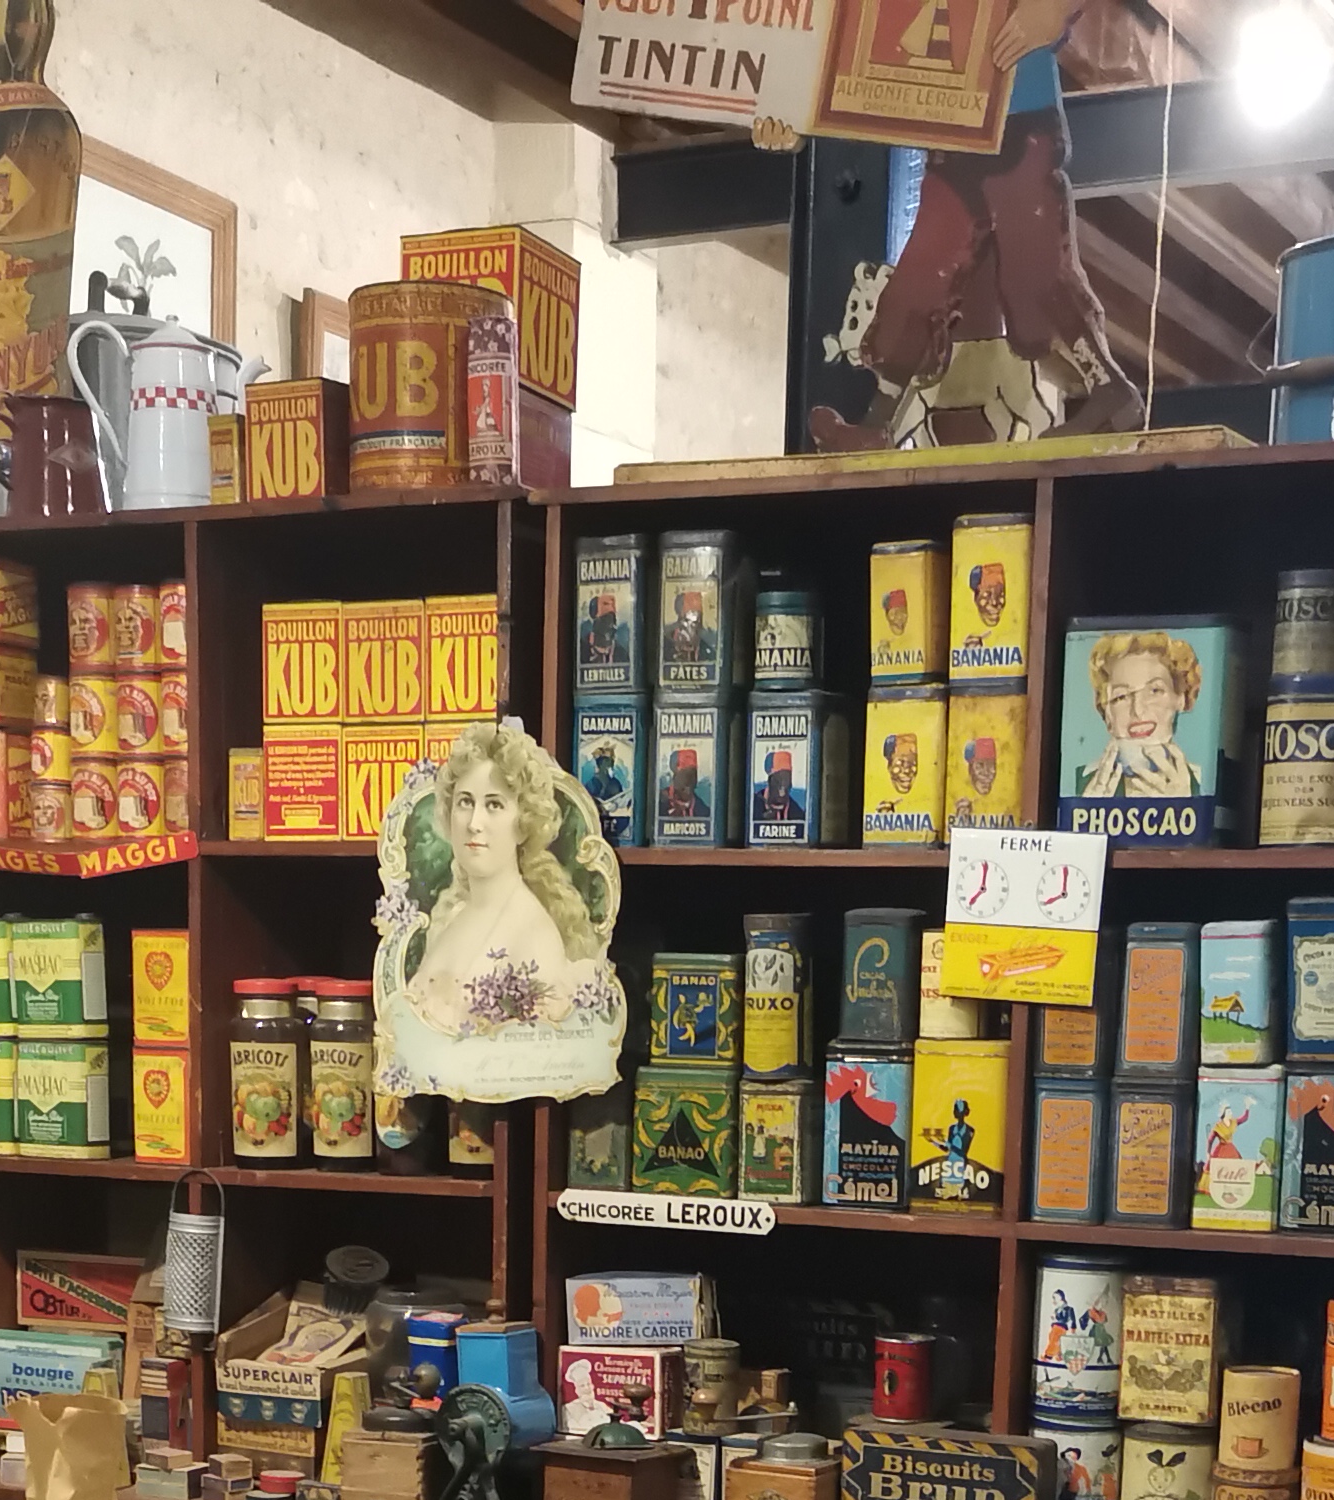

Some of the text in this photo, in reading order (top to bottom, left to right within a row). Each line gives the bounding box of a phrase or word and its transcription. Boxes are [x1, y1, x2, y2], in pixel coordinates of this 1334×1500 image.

[598, 35, 765, 94] TINTIN
[916, 88, 988, 112] LEROUX
[408, 248, 507, 280] BOUILLON
[523, 254, 578, 303] BOUILLON
[519, 282, 575, 395] KUB
[250, 397, 317, 424] BOUILLON
[251, 421, 321, 500] KUB
[580, 557, 630, 581] BANANIA
[267, 620, 335, 642] BOUILLON
[347, 616, 418, 640] BOUILLON
[870, 649, 924, 667] BANANIA
[951, 646, 1022, 667] BANANIA
[267, 641, 338, 716] KUB
[347, 639, 421, 716] KUB
[582, 716, 632, 734] BANANIA
[661, 713, 713, 735] BANANIA
[756, 714, 807, 737] BANANIA
[347, 742, 417, 762] BOUILLON
[759, 824, 797, 838] FARINE
[865, 813, 933, 831] BANANIA
[1072, 806, 1197, 836] PHOSCAO
[1000, 835, 1053, 853] FERMÉ
[77, 837, 177, 878] MAGGI
[657, 1146, 705, 1161] BANAO
[918, 1160, 990, 1190] NESCAO
[566, 1200, 763, 1230] CHICORÉE LEROUX
[1132, 1308, 1206, 1322] PASTILLES
[579, 1326, 633, 1339] RIVOIRE
[642, 1326, 694, 1338] CARRET
[12, 1362, 74, 1381] bougie
[223, 1366, 313, 1385] SUPERCLAIR
[881, 1453, 996, 1483] Biscuits
